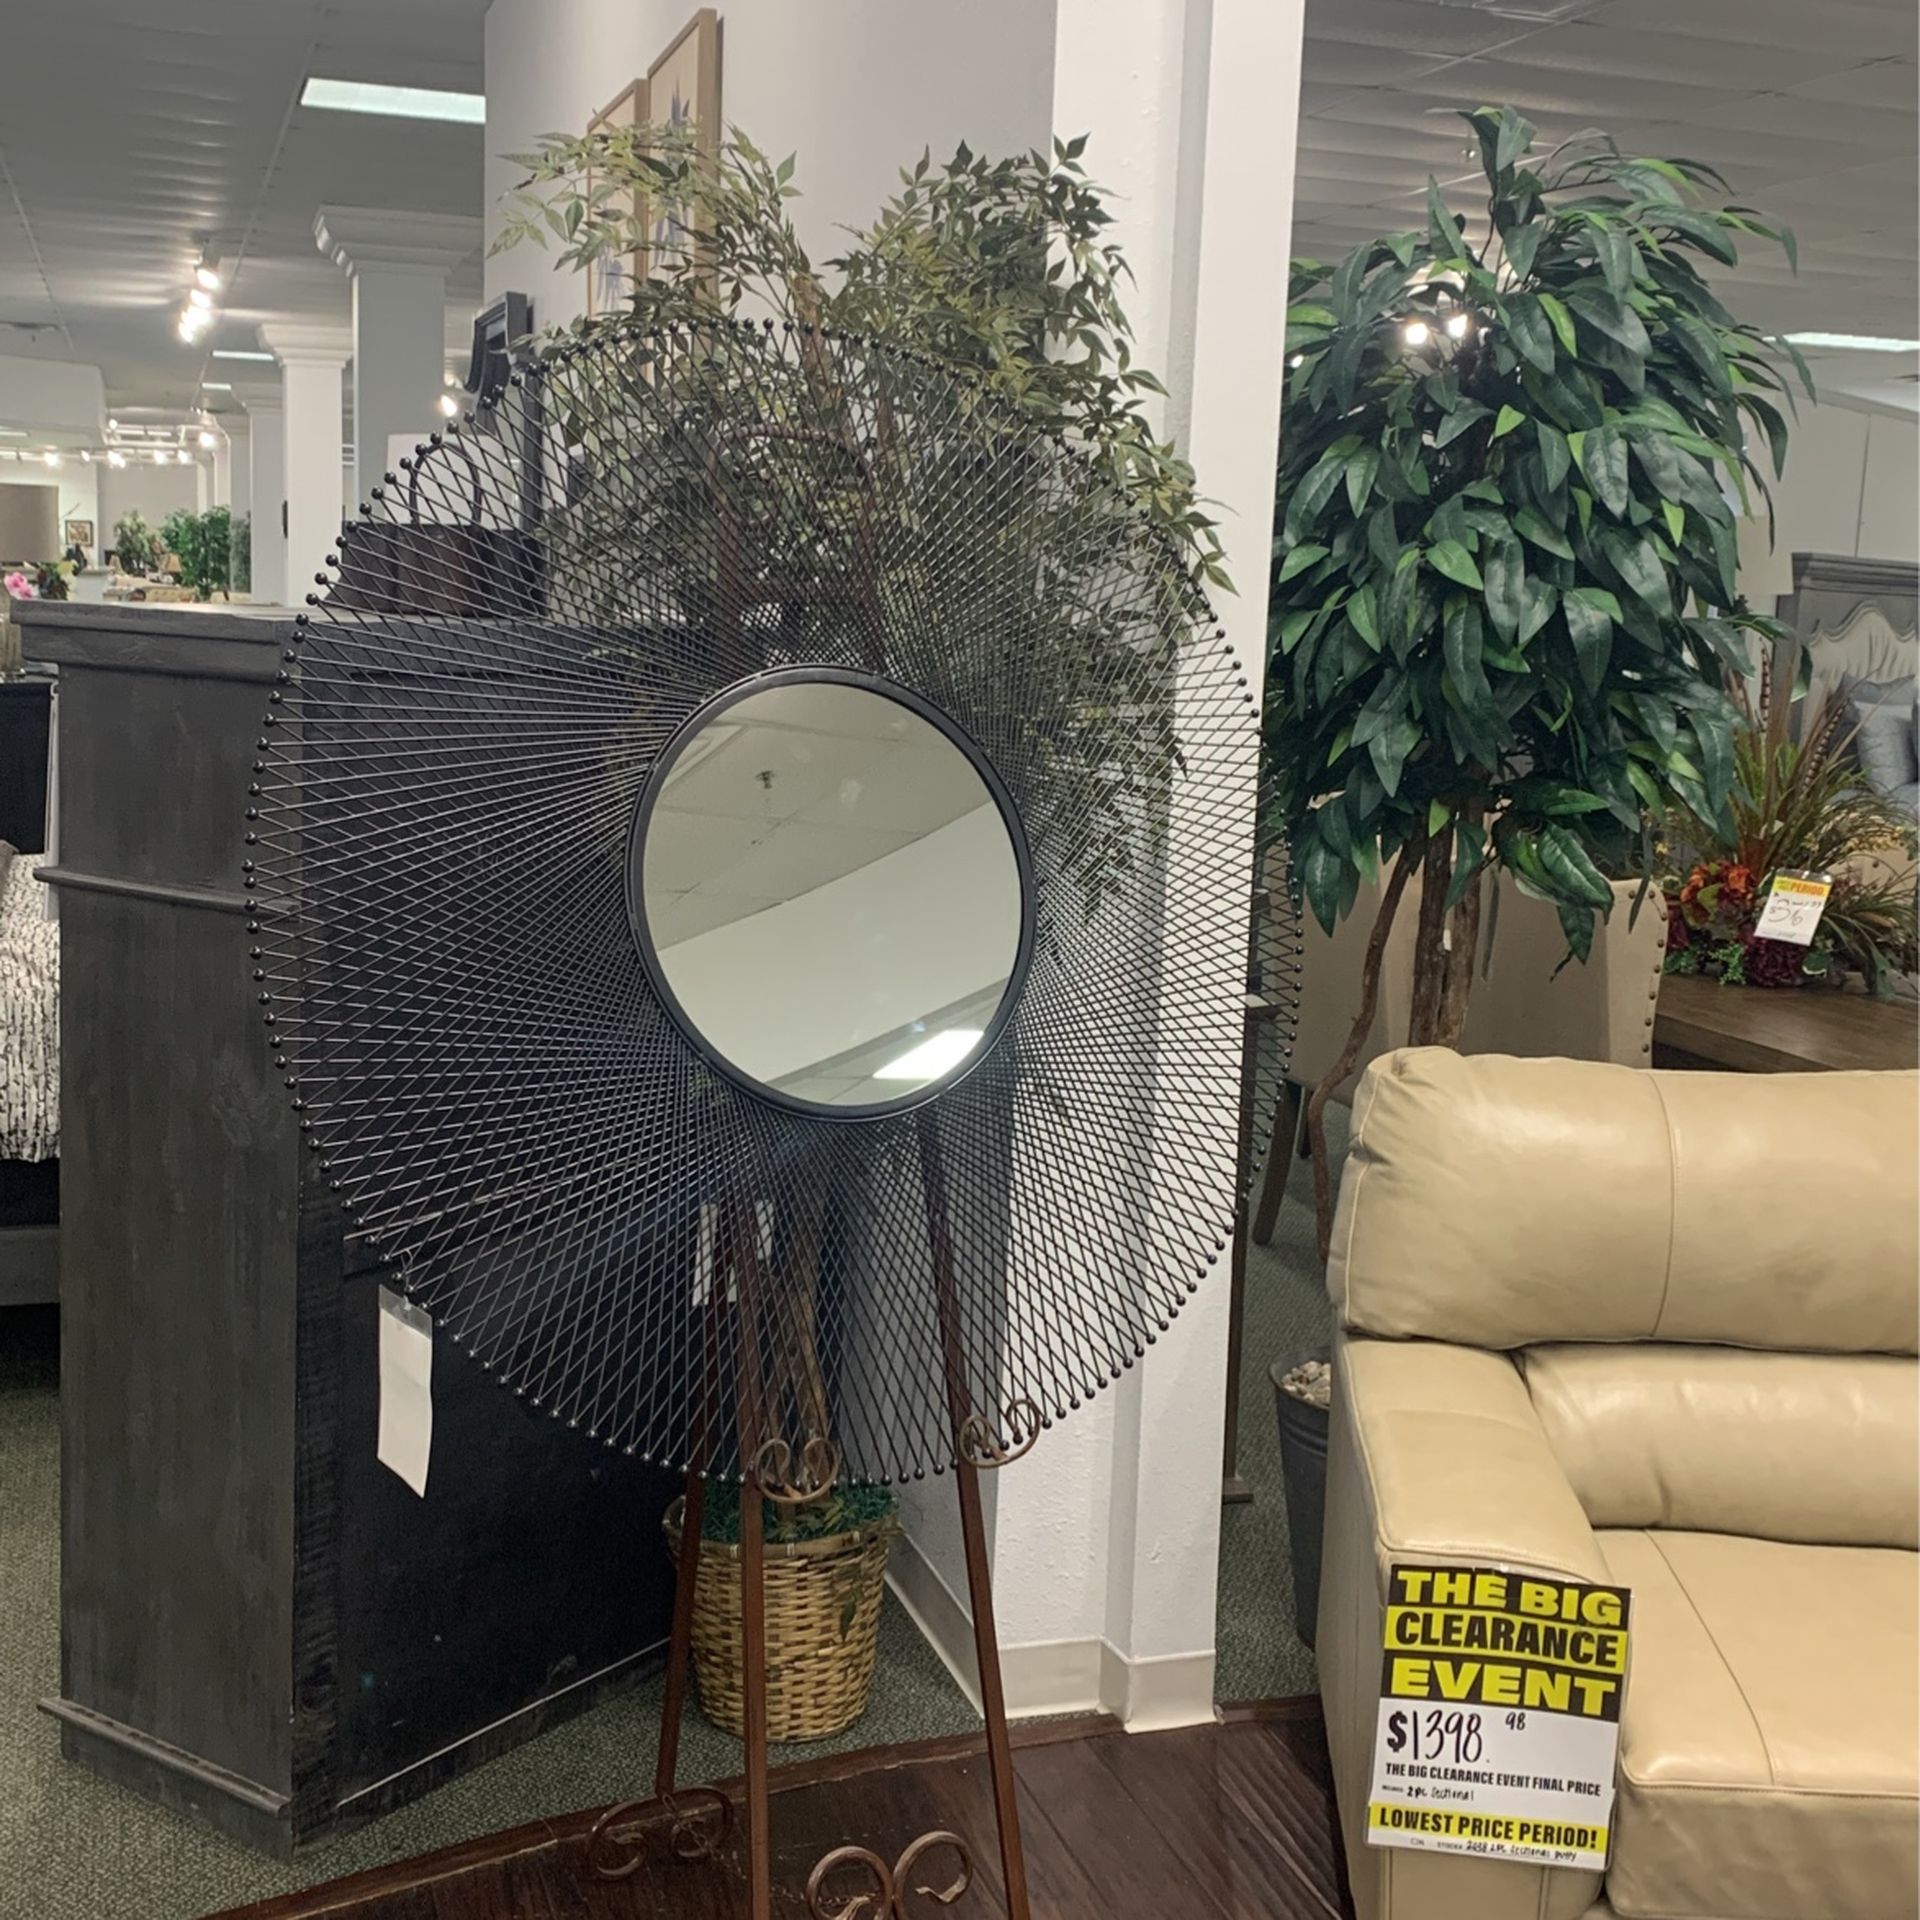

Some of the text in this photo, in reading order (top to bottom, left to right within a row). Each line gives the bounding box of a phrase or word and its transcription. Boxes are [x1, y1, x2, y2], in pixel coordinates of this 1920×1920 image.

[1397, 1570, 1622, 1627] THE BIG
[1395, 1611, 1618, 1668] CLEARANCE
[1391, 1657, 1616, 1716] EVENT
[1505, 1711, 1526, 1730] 98
[1386, 1763, 1602, 1797] THE BIG CLEARANCE EVENT FINAL PRICE
[1379, 1807, 1598, 1849] LOWEST PRICE PERIOD!
